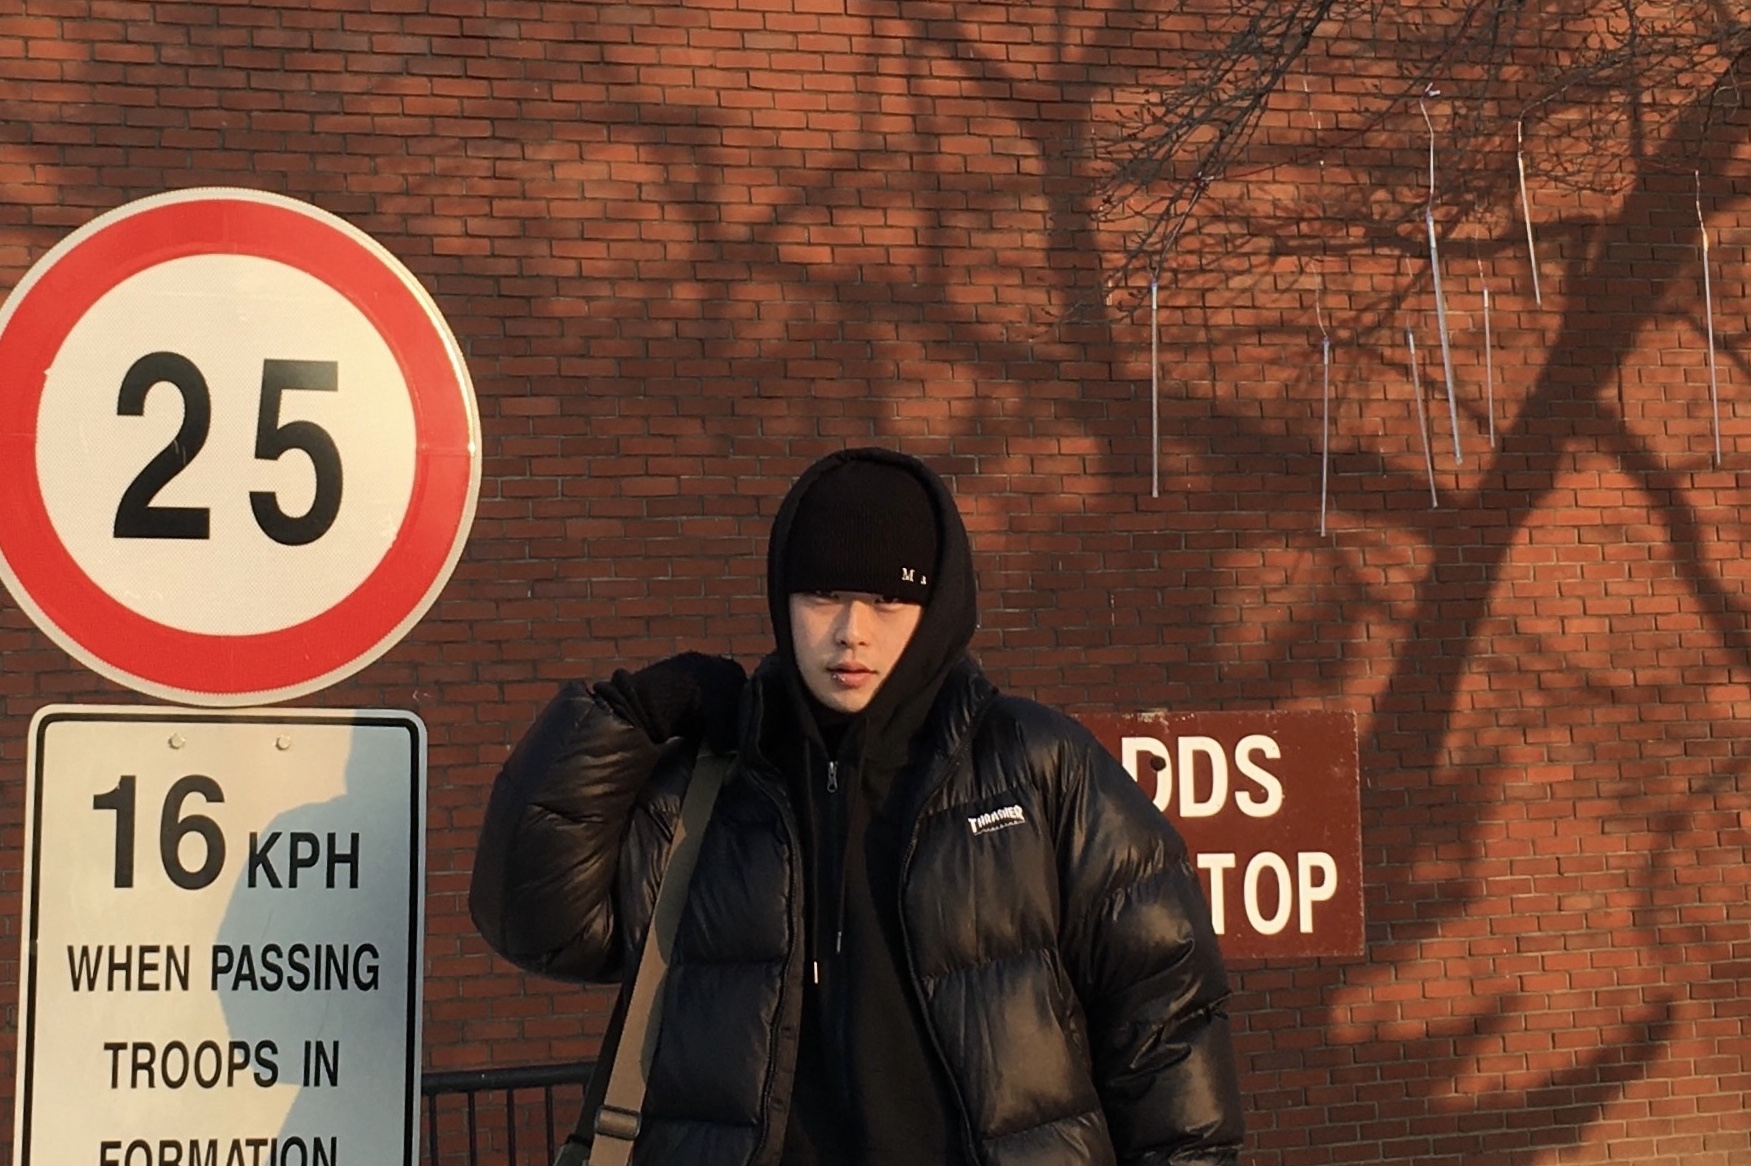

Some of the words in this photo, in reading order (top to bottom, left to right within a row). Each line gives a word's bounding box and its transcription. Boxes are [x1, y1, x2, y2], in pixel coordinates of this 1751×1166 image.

[113, 351, 343, 546] 25
[93, 775, 226, 890] 16
[247, 832, 360, 889] KPH
[967, 804, 1025, 834] THRASHER
[67, 945, 190, 992] WHEN
[211, 943, 380, 992] PASSING
[103, 1040, 279, 1089] TROOPS
[303, 1041, 340, 1088] IN
